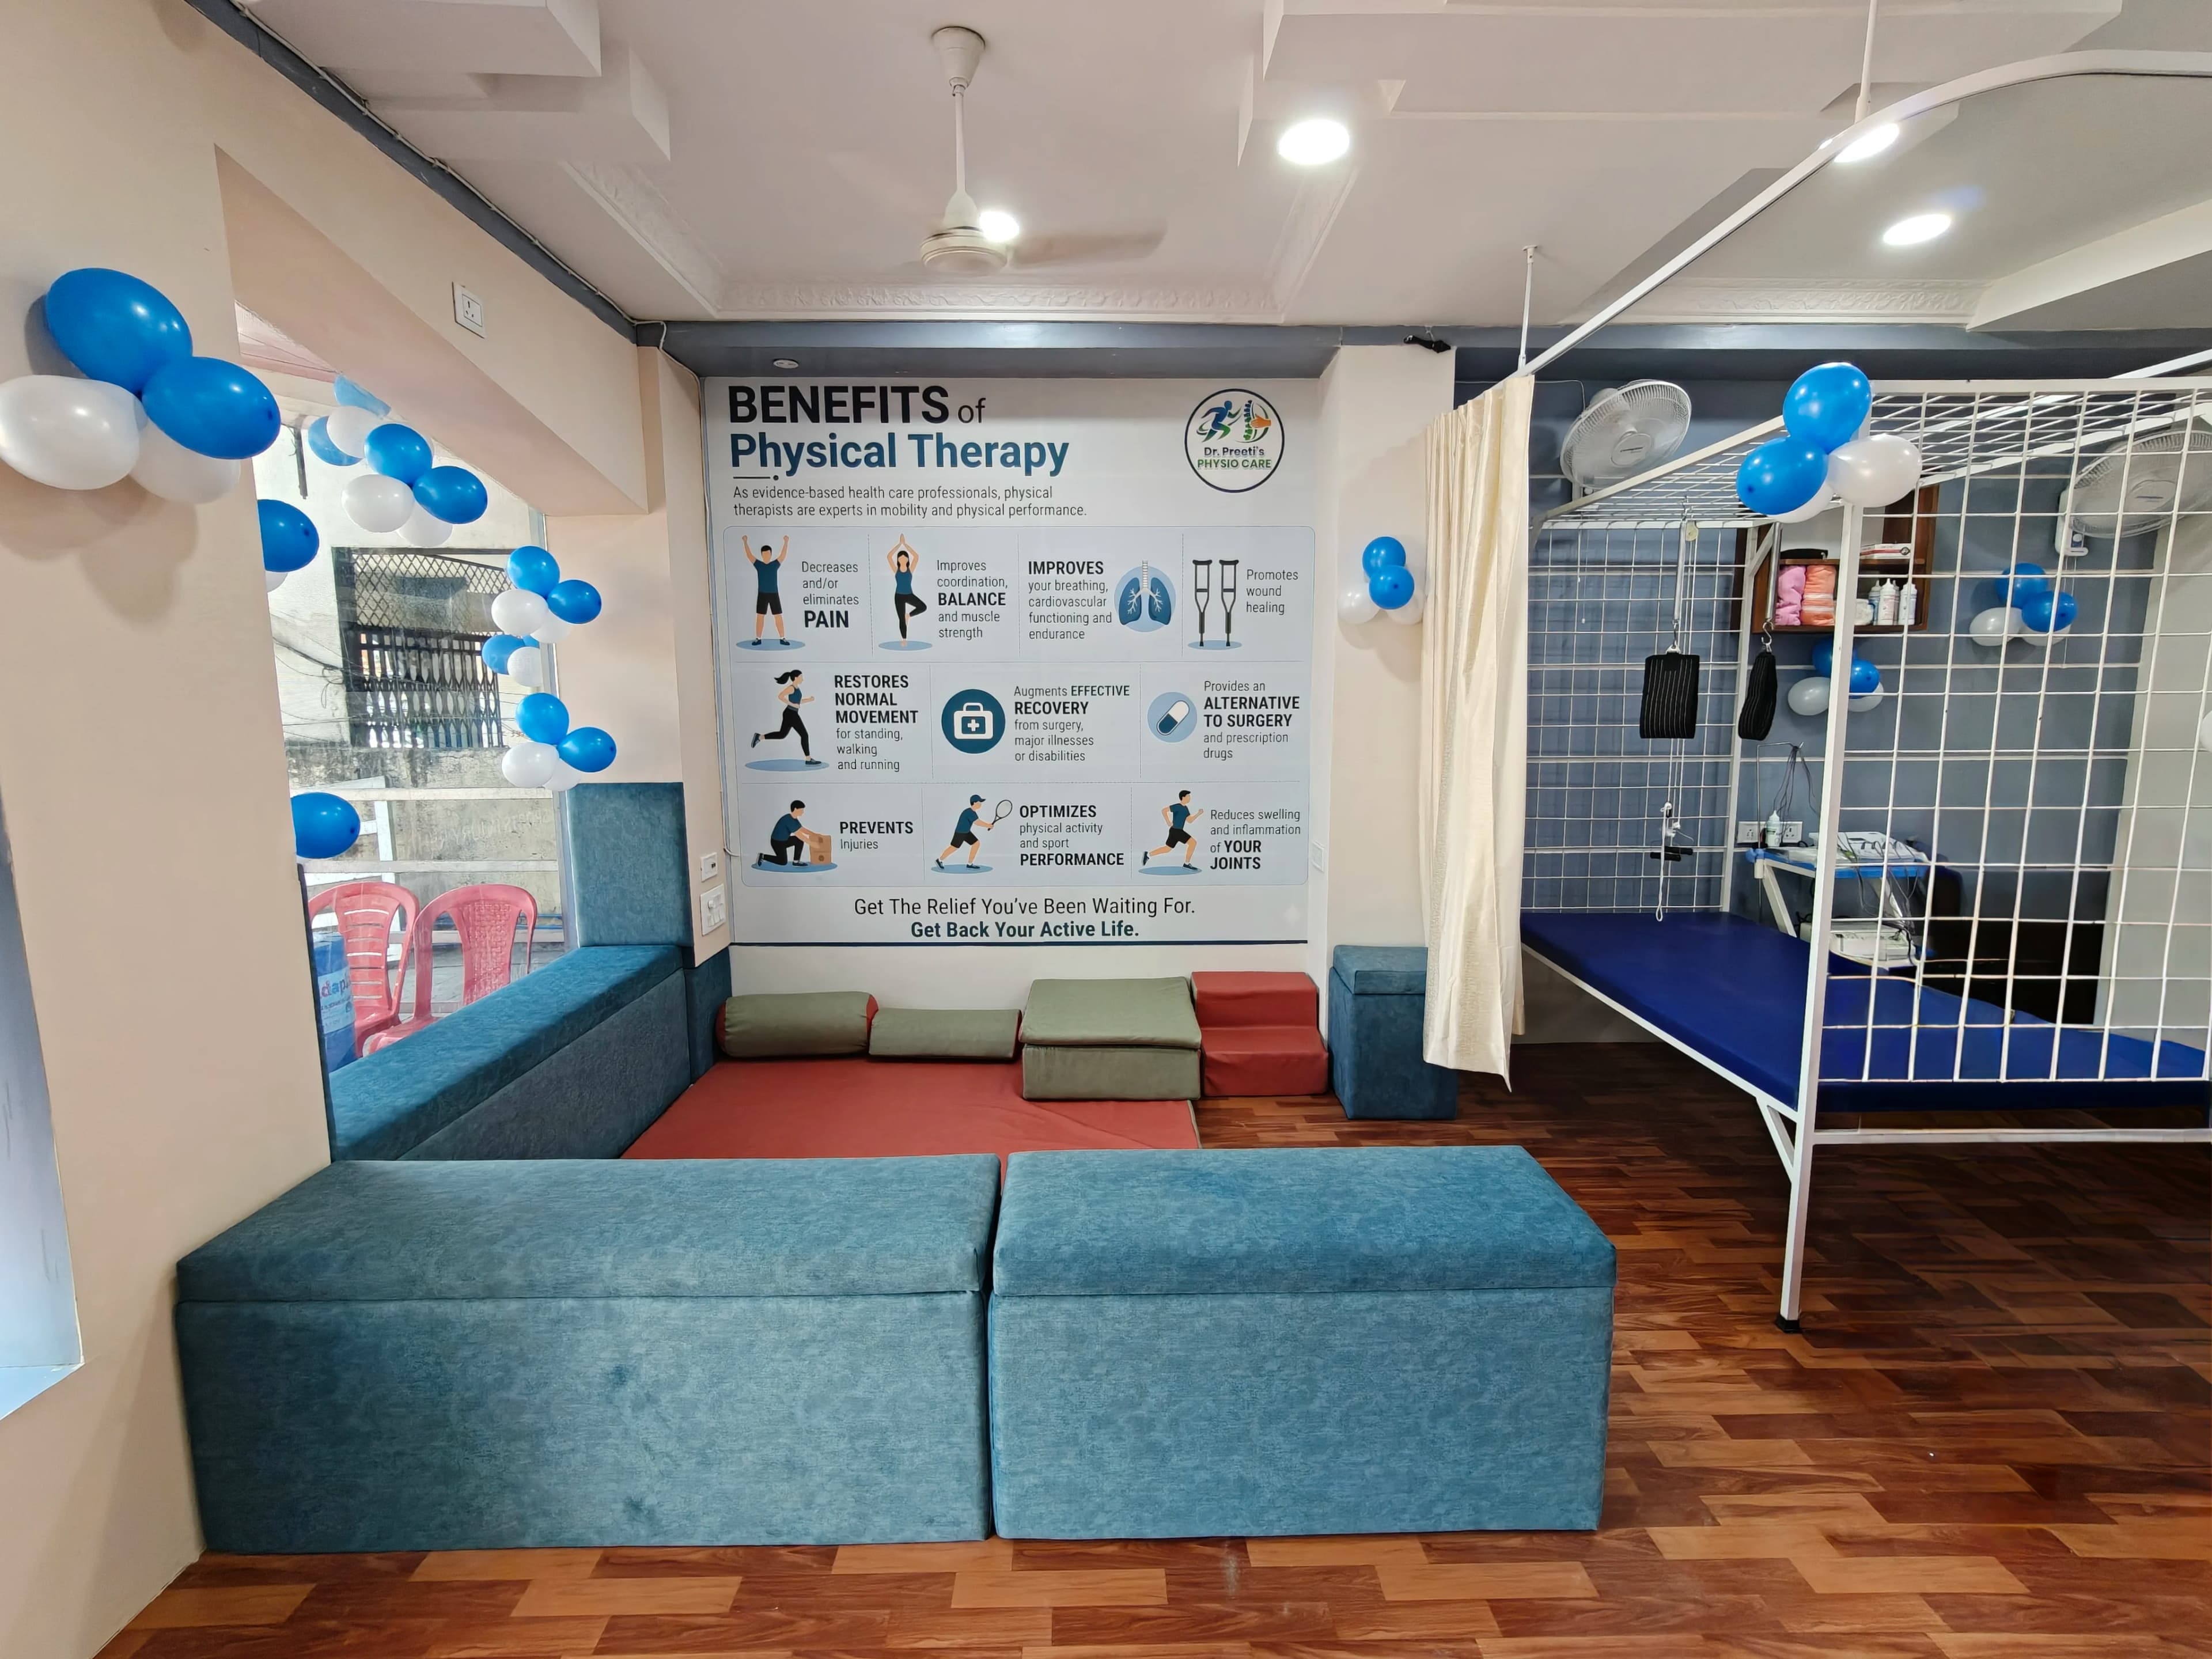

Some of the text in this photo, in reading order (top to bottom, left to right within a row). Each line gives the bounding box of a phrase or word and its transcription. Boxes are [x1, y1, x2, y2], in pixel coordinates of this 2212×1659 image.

[728, 385, 986, 424] BENEFITS of
[729, 431, 1070, 477] Physical Therapy
[1204, 445, 1265, 456] Dr. Preeti's
[1197, 459, 1272, 468] PHYSIO CARE
[732, 484, 1052, 502] As evidence-based health care professionals, physical
[733, 502, 1086, 519] therapists are experts in mobility and physical performance.
[801, 560, 858, 573] Decreases
[937, 559, 987, 573] Improves
[1028, 560, 1104, 575] IMPROVES
[937, 575, 1008, 589] coordination,
[1247, 569, 1298, 581] Promotes
[802, 577, 839, 589] and/or
[1028, 579, 1108, 594] your breathing,
[1246, 585, 1282, 597] wound
[803, 593, 859, 605] eliminates
[938, 592, 1006, 606] BALANCE
[1028, 595, 1107, 607] cardiovascular
[1246, 601, 1285, 616] healing
[804, 610, 849, 628] PAIN
[938, 610, 1000, 622] and muscle
[1029, 611, 1112, 626] functioning and
[938, 626, 983, 641] strength
[1029, 628, 1085, 639] endurance
[834, 675, 909, 688] RESTORES
[1204, 680, 1266, 692] Provides an
[835, 692, 897, 706] NORMAL
[1014, 685, 1130, 699] Augments EFFECTIVE
[1014, 701, 1089, 715] RECOVERY
[1203, 696, 1300, 710] ALTERNATIVE
[835, 710, 919, 724] MOVEMENT
[1203, 714, 1293, 728] TO SURGERY
[1014, 718, 1084, 733] from surgery,
[836, 728, 903, 742] for standing,
[1014, 734, 1094, 749] major illnesses
[1203, 732, 1289, 745] and prescription
[836, 743, 877, 757] walking
[1014, 749, 1085, 762] or disabilities
[1203, 747, 1233, 761] drugs
[838, 759, 900, 772] and running
[1020, 805, 1097, 818] OPTIMIZES
[1210, 808, 1300, 822] Reduces swelling
[839, 821, 914, 834] PREVENTS
[1020, 822, 1103, 836] physical activity
[1210, 824, 1301, 835] and inflammation
[840, 838, 878, 852] Injuries
[1020, 837, 1069, 851] and sport
[1210, 840, 1262, 853] of YOUR
[1020, 853, 1124, 866] PERFORMANCE
[1210, 857, 1261, 870] JOINTS
[854, 897, 1195, 918] Get The Relief You've Been Waiting For.
[911, 919, 1139, 938] Get Back Your Active Life.
